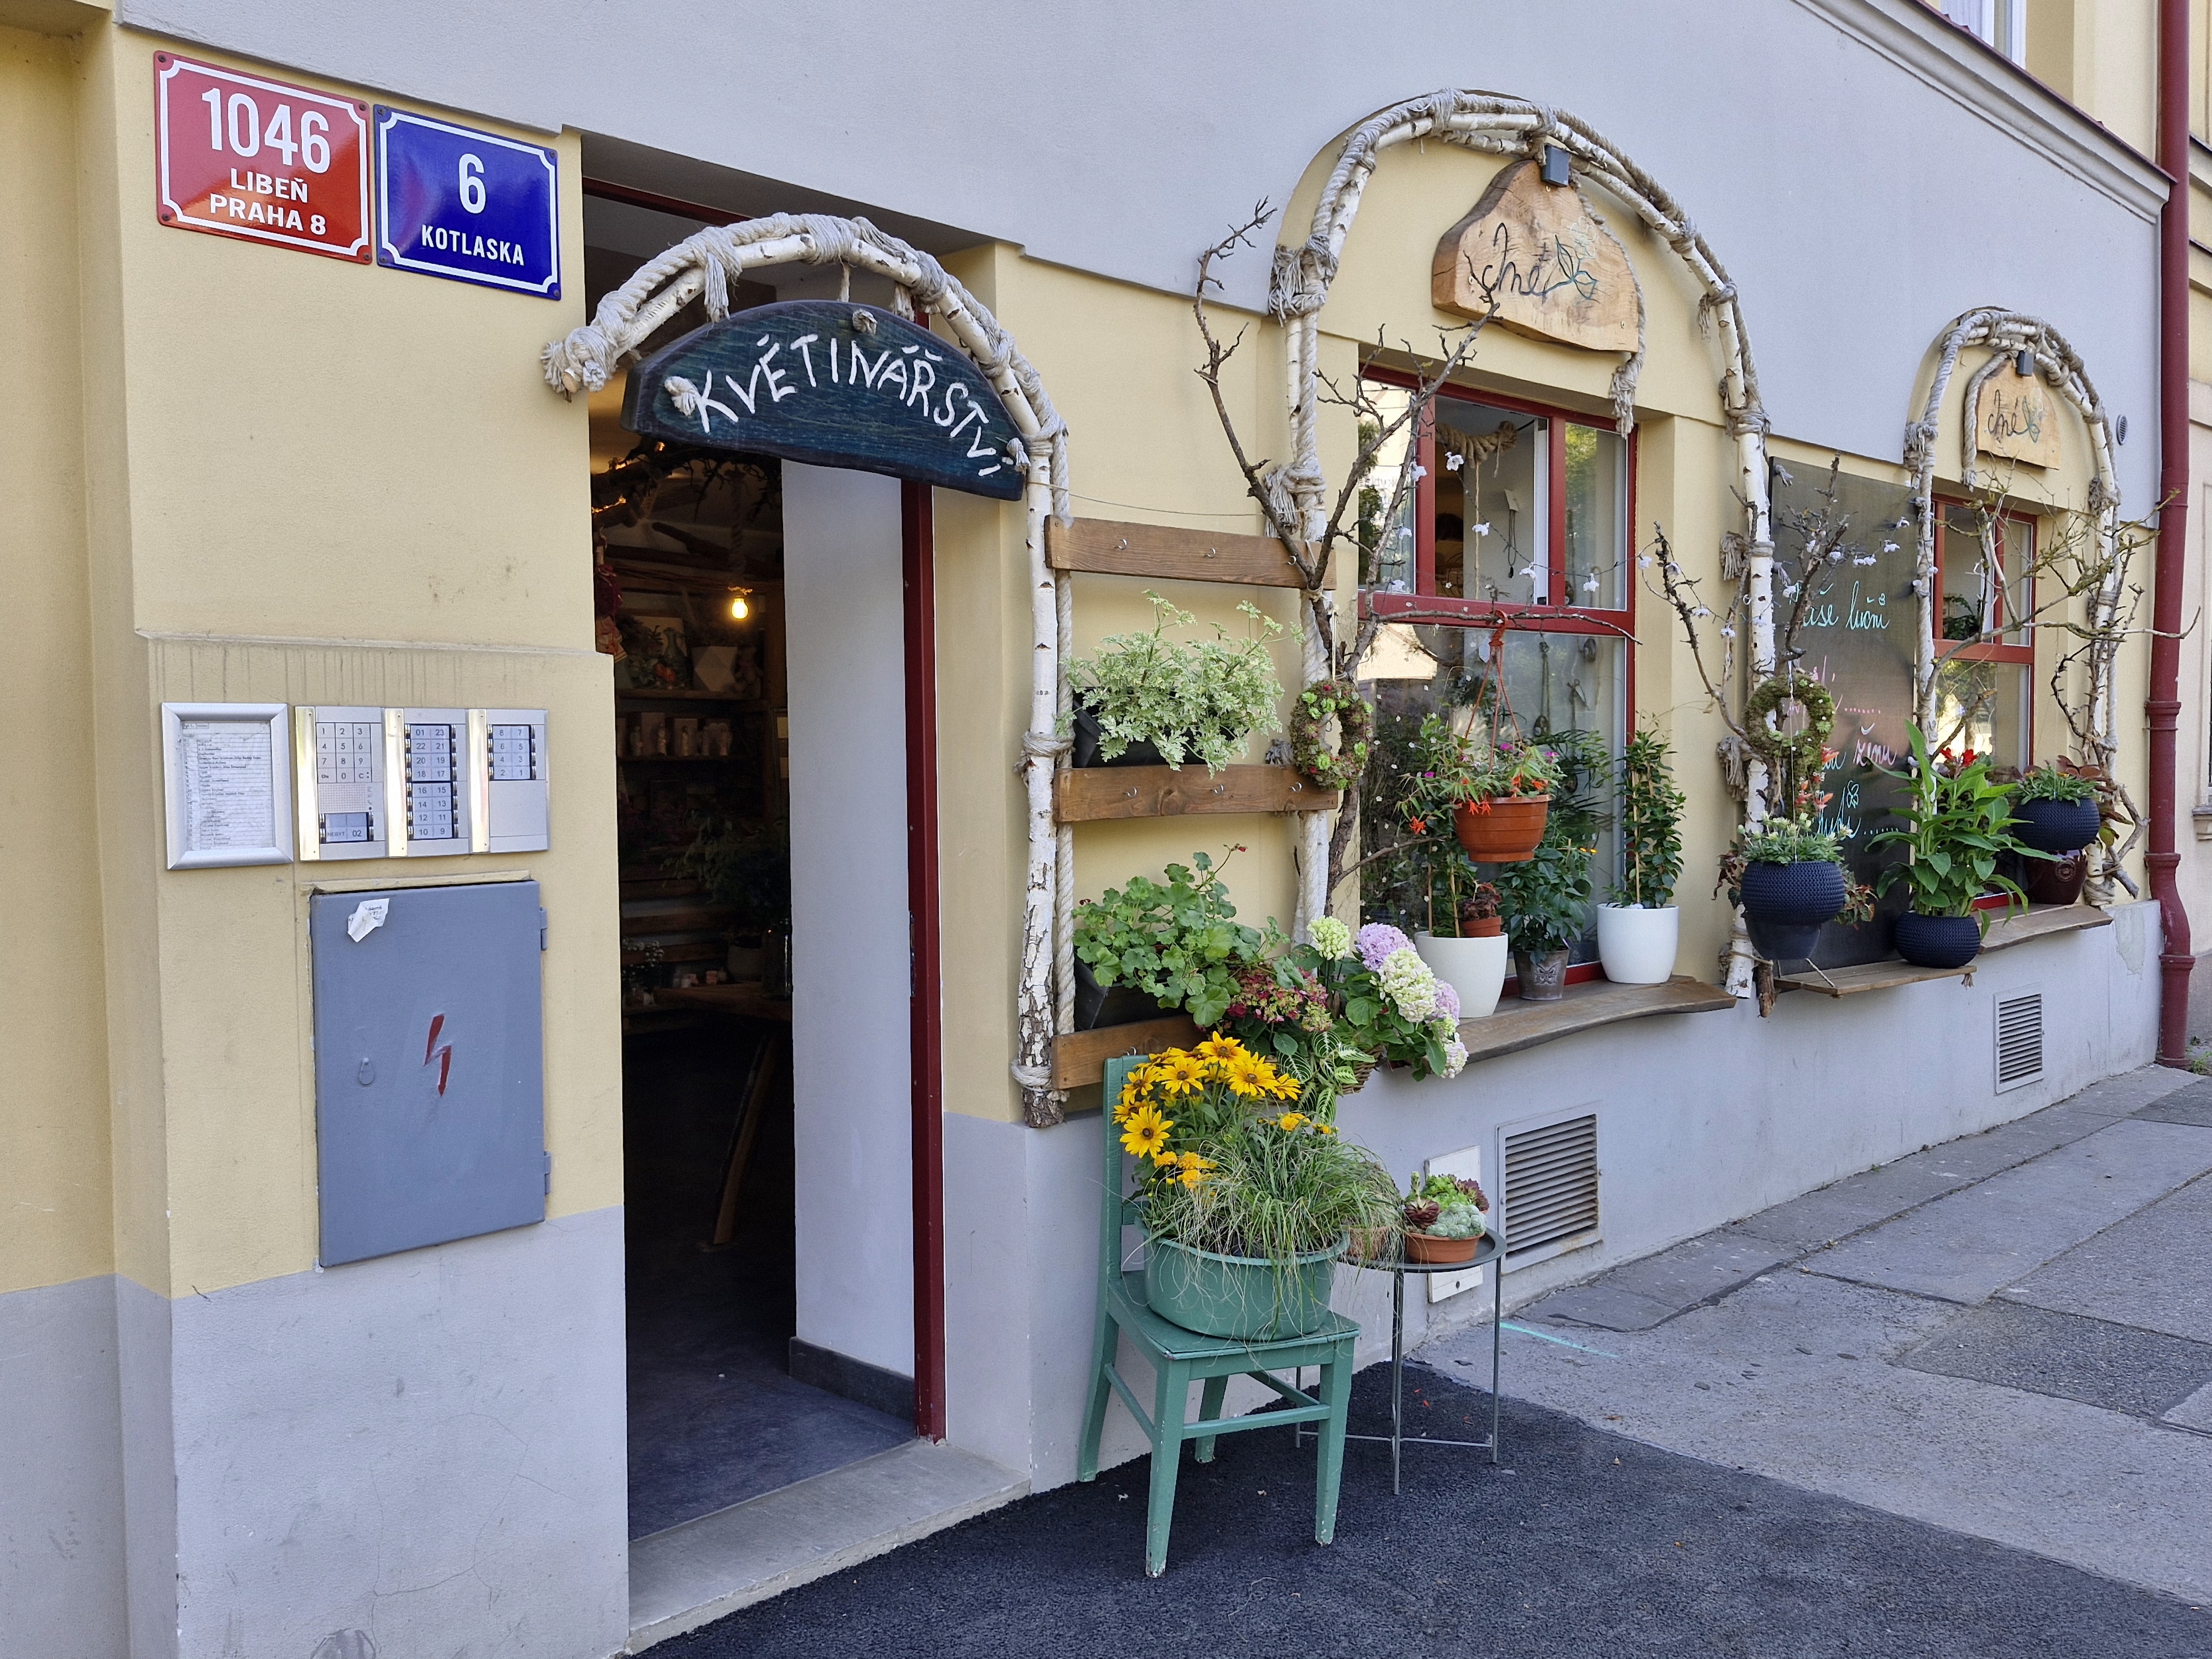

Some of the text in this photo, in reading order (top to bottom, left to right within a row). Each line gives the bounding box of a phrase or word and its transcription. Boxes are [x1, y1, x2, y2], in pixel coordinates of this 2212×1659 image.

[201, 87, 331, 174] 1046
[230, 168, 309, 204] LIBEŇ
[458, 153, 487, 214] 6
[210, 193, 327, 236] PRAHA 8
[421, 225, 525, 266] KOTLASKA
